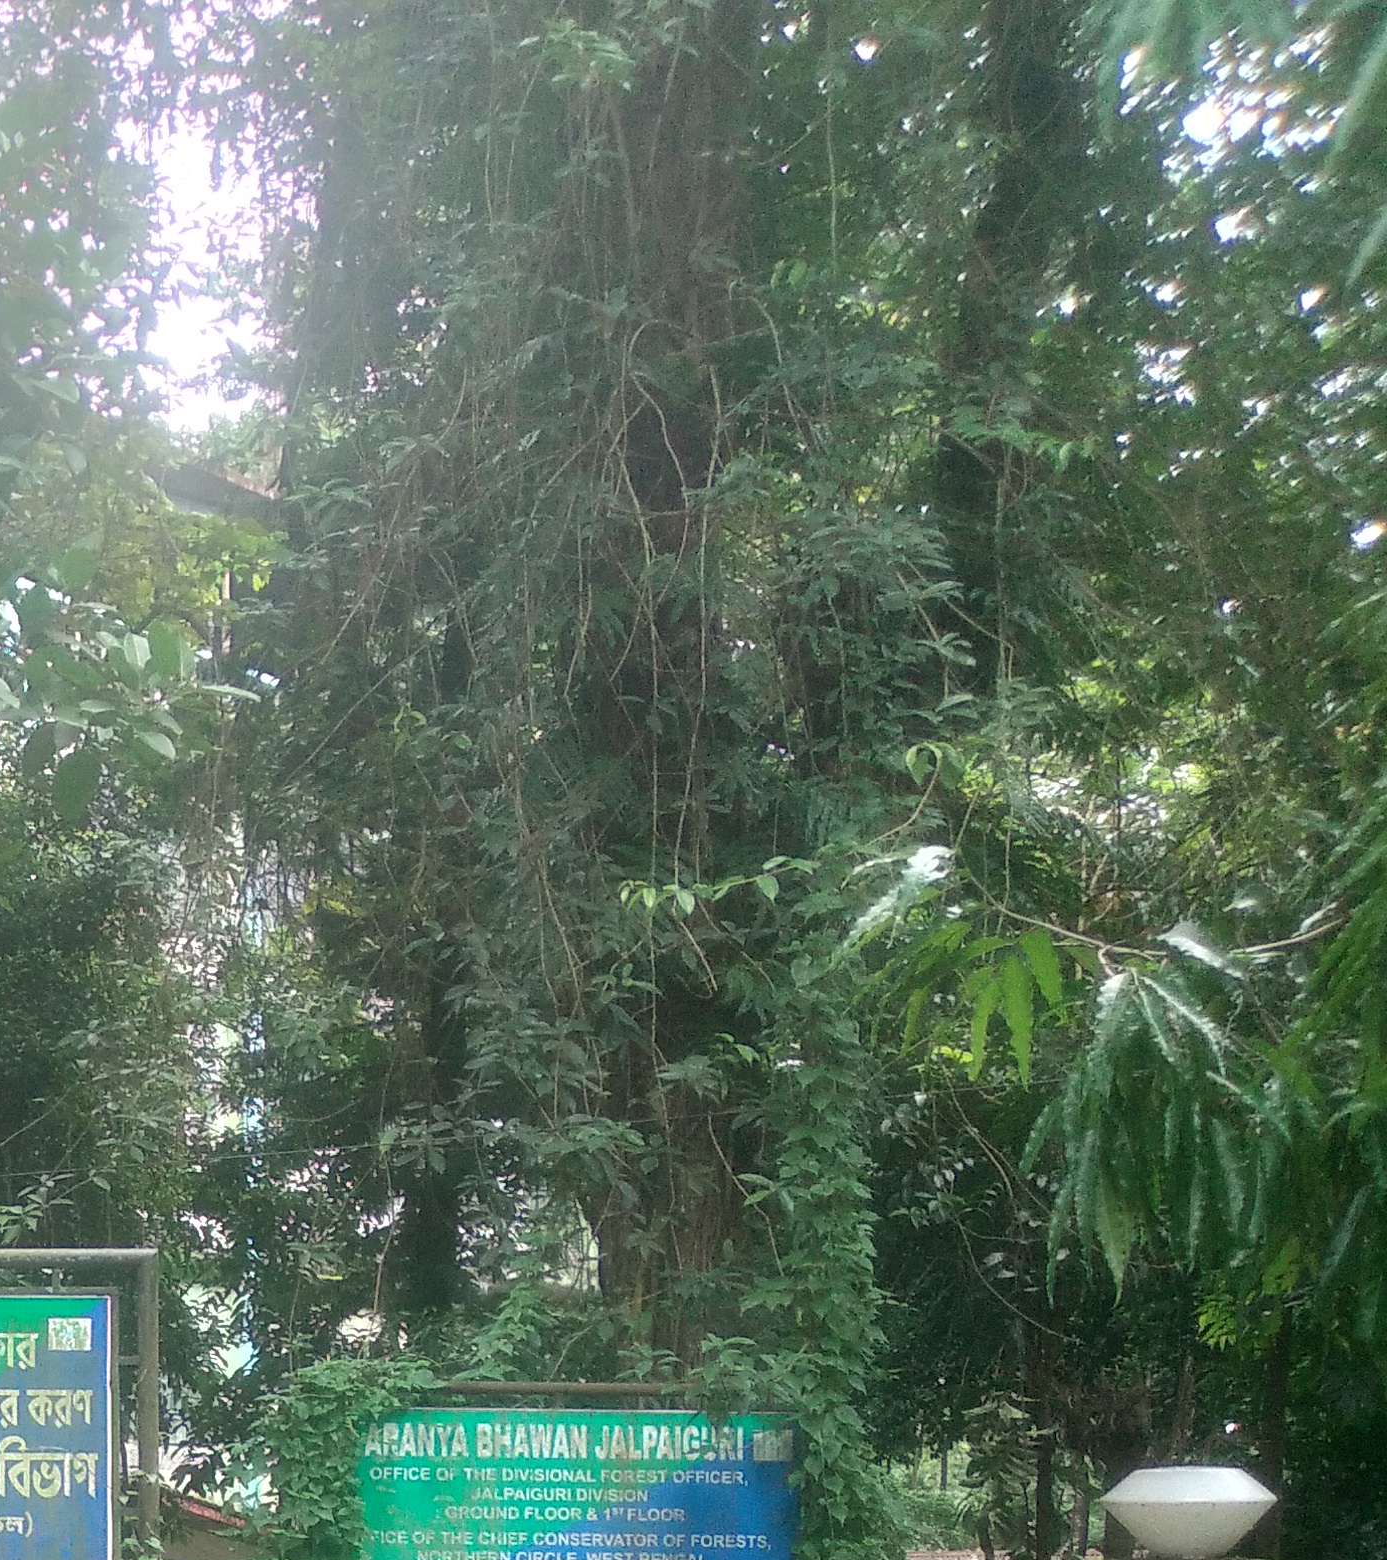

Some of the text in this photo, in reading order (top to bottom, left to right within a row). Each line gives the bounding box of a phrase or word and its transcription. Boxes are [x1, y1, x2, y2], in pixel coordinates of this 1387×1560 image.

[27, 1389, 94, 1428] করণ
[364, 1422, 745, 1462] ARANYA BHAWAN JALPAIGURI
[369, 1466, 749, 1488] OFFICE OF THE DIVISIONAL FOREST OFFICER,
[471, 1486, 649, 1503] JALPAIGURI DIVISION
[444, 1505, 520, 1520] GROUND
[523, 1506, 582, 1521] FLOOR
[586, 1507, 598, 1521] &
[626, 1508, 687, 1523] FLOOR
[411, 1531, 436, 1546] OF
[440, 1531, 473, 1546] THE
[478, 1531, 529, 1547] CHIEF
[532, 1532, 660, 1548] CONSERVATOR
[663, 1533, 687, 1548] OF
[690, 1534, 773, 1551] FORESTS,
